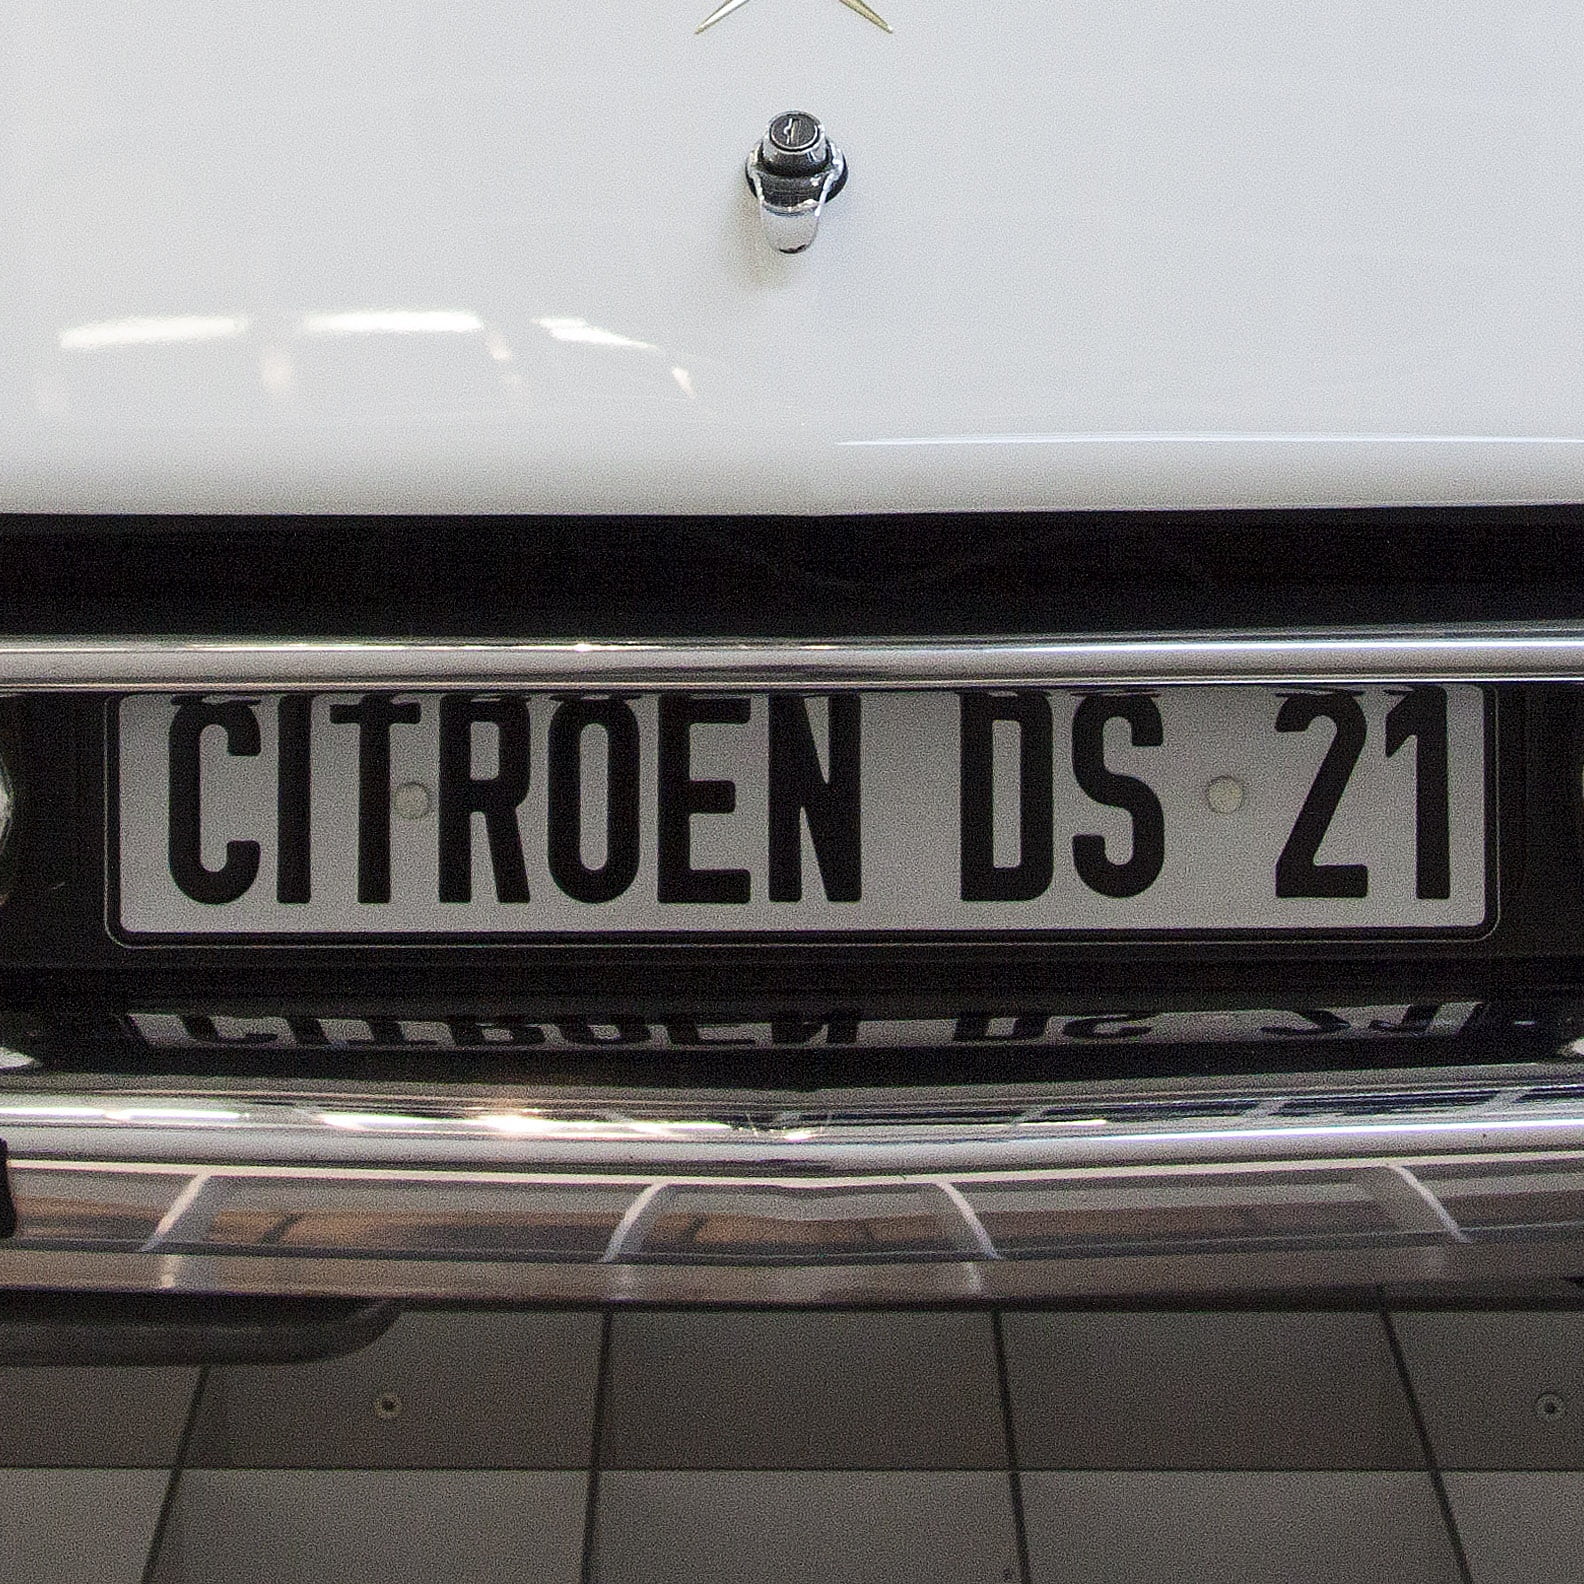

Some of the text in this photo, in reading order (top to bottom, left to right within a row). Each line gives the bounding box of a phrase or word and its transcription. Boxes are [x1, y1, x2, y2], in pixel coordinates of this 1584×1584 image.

[167, 687, 1452, 905] CITROEN DS 21
